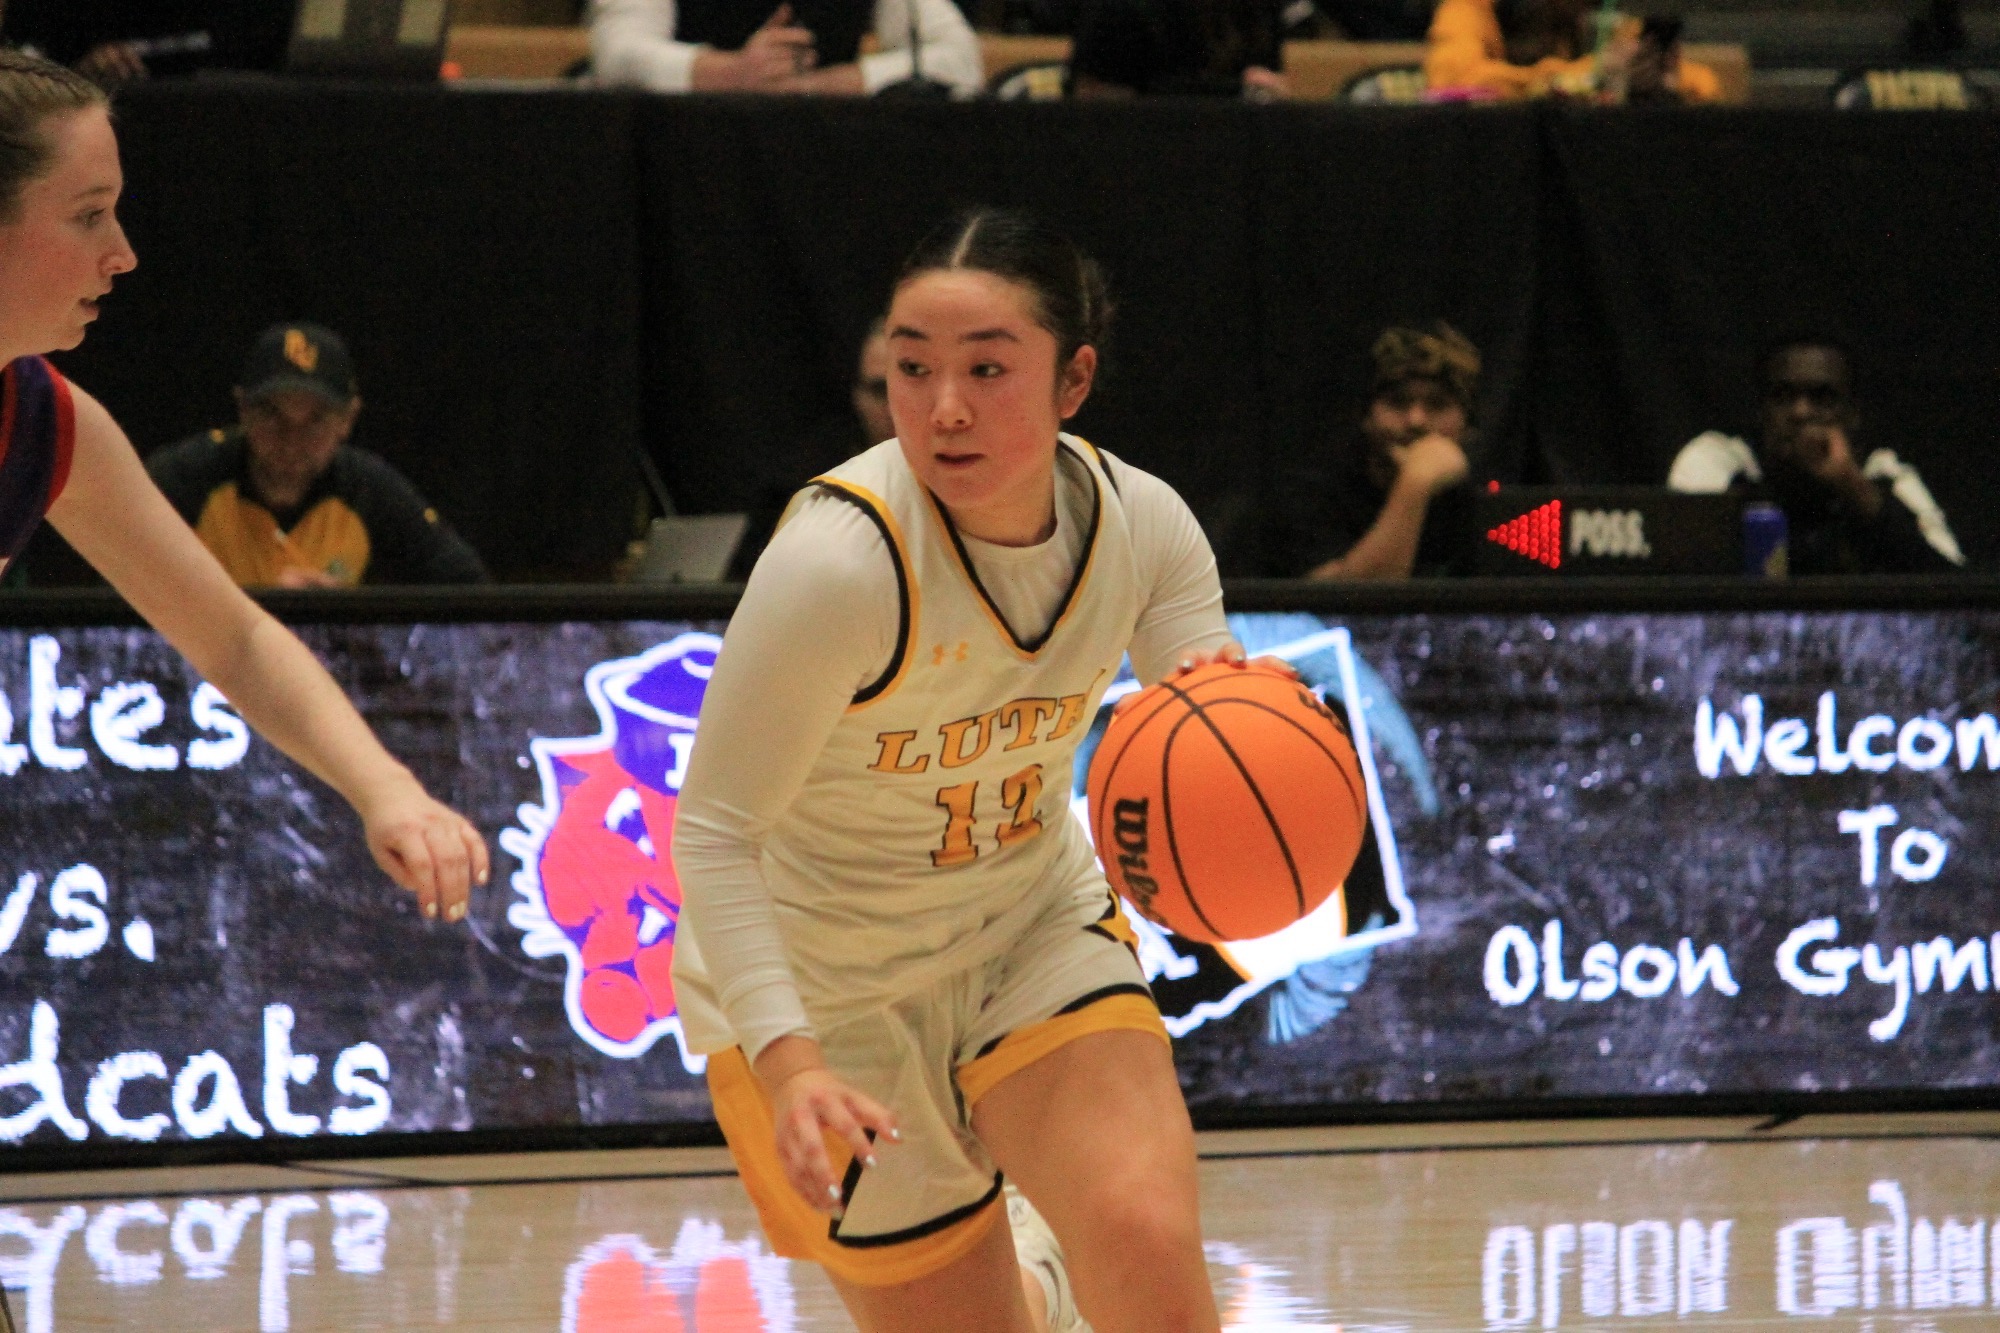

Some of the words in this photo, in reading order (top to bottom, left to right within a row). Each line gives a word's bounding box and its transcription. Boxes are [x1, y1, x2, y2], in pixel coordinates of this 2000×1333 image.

[1570, 510, 1650, 557] POSS.
[867, 671, 1104, 774] LUTE
[930, 763, 1043, 867] 12
[1837, 804, 1949, 887] To
[1483, 919, 1740, 1008] Olson
